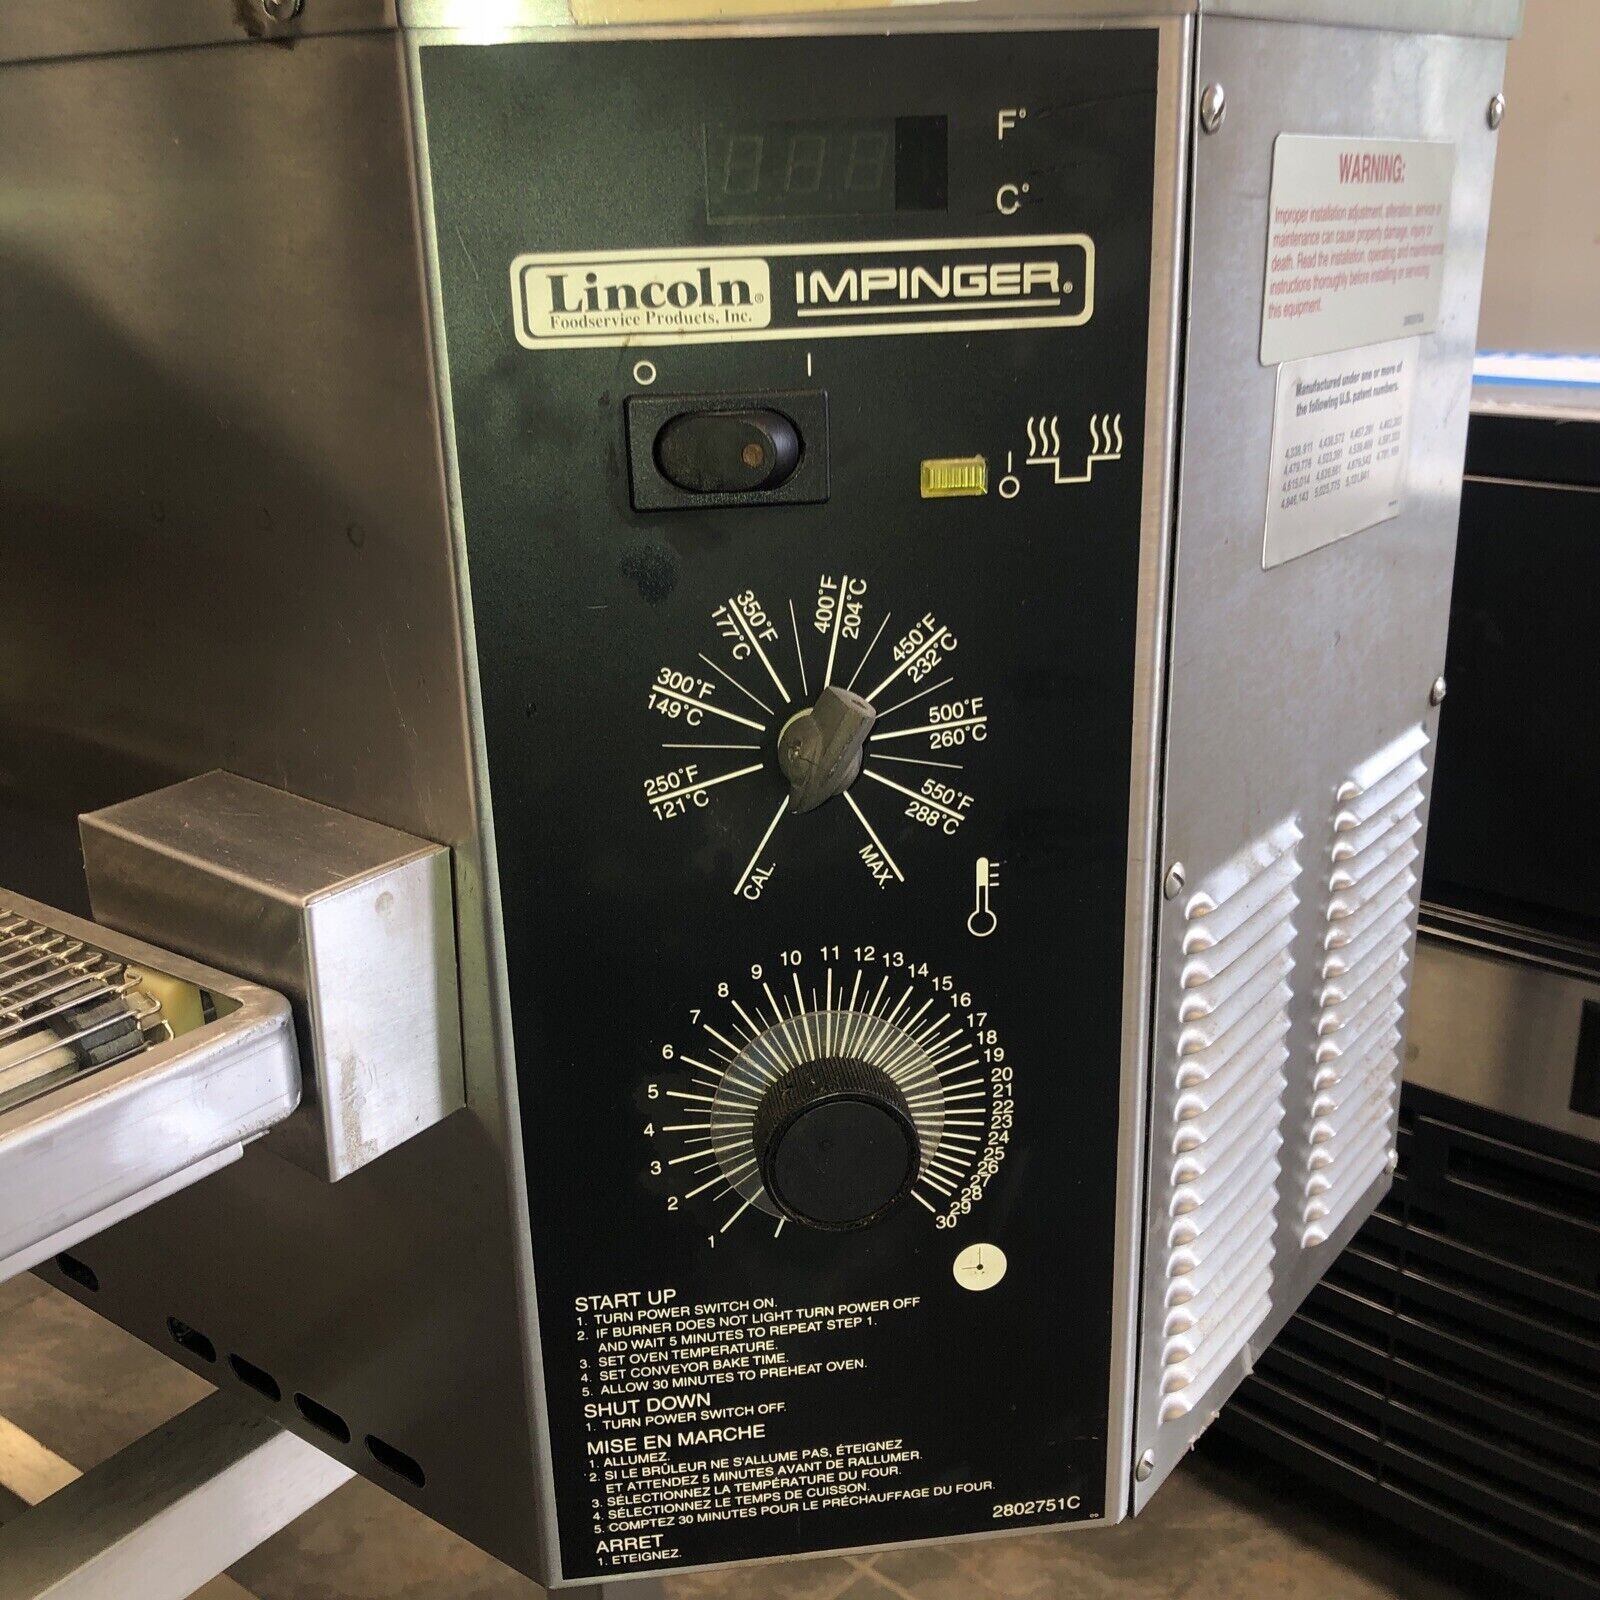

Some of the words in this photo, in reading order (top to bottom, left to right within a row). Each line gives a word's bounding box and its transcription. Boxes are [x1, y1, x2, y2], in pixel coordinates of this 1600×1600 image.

[1339, 152, 1405, 184] WARNING:
[795, 261, 1061, 303] IMPINGER
[550, 312, 641, 330] Foodservice
[646, 310, 720, 328] Products,
[724, 309, 752, 324] Inc.
[1296, 374, 1341, 397] Manufactured
[1343, 373, 1360, 386] under
[1309, 395, 1338, 414] following
[1352, 389, 1372, 403] patent
[738, 590, 778, 642] 350°F
[814, 575, 838, 634] 400°F
[842, 578, 866, 639] 204°C
[711, 605, 751, 660] 177°C
[892, 612, 937, 663] 450°F
[907, 635, 958, 682] 232°C
[657, 667, 716, 698] 300°F
[647, 694, 704, 726] 149°C
[929, 697, 984, 723] 500°F
[929, 724, 988, 749] 260°C
[644, 765, 700, 797] 250°F
[652, 790, 709, 820] 121°C
[920, 779, 975, 810] 550°F
[904, 802, 960, 836] 288°C
[859, 843, 893, 890] MAX.
[743, 861, 777, 900] CAL.
[780, 950, 802, 966] 10
[820, 946, 839, 960] 11
[854, 946, 875, 962] 12
[883, 952, 904, 967] 13
[751, 965, 762, 979] 9
[908, 964, 928, 978] 14
[718, 983, 729, 997] 8
[932, 977, 953, 991] 15
[950, 993, 971, 1007] 16
[690, 1010, 700, 1024] 7
[967, 1013, 987, 1027] 17
[977, 1030, 997, 1045] 18
[663, 1045, 674, 1059] 6
[984, 1048, 1004, 1063] 19
[991, 1068, 1012, 1082] 20
[648, 1084, 659, 1099] 5
[993, 1084, 1012, 1097] 21
[992, 1100, 1013, 1114] 22
[644, 1123, 655, 1137] 4
[991, 1116, 1012, 1129] 23
[988, 1131, 1009, 1144] 24
[984, 1147, 1004, 1161] 25
[650, 1161, 662, 1175] 3
[977, 1161, 998, 1174] 26
[970, 1175, 991, 1188] 27
[668, 1196, 678, 1210] 2
[961, 1188, 982, 1201] 28
[950, 1202, 971, 1215] 29
[936, 1215, 957, 1229] 30
[708, 1236, 714, 1248] 1
[574, 1291, 641, 1312] START
[647, 1288, 676, 1305] UP
[576, 1316, 587, 1326] 1.
[593, 1311, 633, 1324] TURN
[637, 1305, 690, 1320] POWER
[694, 1300, 749, 1315] SWITCH
[752, 1297, 777, 1309] ON.
[576, 1330, 588, 1341] 2.
[596, 1327, 608, 1339] IF
[612, 1322, 672, 1337] BURNER
[675, 1317, 716, 1331] DOES
[719, 1314, 748, 1326] NOT
[752, 1309, 793, 1323] LIGHT
[795, 1305, 834, 1319] TURN
[838, 1299, 889, 1314] POWER
[892, 1296, 920, 1309] OFF
[597, 1340, 628, 1353] AND
[631, 1336, 666, 1349] WAIT
[680, 1328, 744, 1345] 5
[746, 1326, 766, 1338] MINUTES
[769, 1320, 823, 1336] TO
[826, 1316, 862, 1330] REPEAT
[866, 1315, 877, 1326] 1.
[579, 1358, 590, 1369] 3.
[598, 1354, 625, 1367] SET
[628, 1350, 668, 1364] OVEN
[670, 1339, 778, 1359] TEMPERATURE.
[580, 1372, 592, 1382] 4.
[599, 1368, 626, 1381] SET
[630, 1360, 709, 1378] CONVEYOR
[712, 1356, 750, 1370] BAKE
[752, 1352, 788, 1365] TIME.
[582, 1386, 593, 1396] 5.
[600, 1380, 648, 1395] ALLOW
[652, 1379, 668, 1390] 30
[672, 1372, 734, 1388] MINUTES
[736, 1369, 756, 1380] TO
[759, 1362, 822, 1378] PREHEAT
[826, 1358, 867, 1372] OVEN.
[584, 1399, 640, 1418] SHUT
[646, 1392, 710, 1412] DOWN
[586, 1422, 596, 1431] 1.
[602, 1417, 641, 1430] TURN
[644, 1411, 696, 1426] POWER
[700, 1405, 754, 1420] SWITCH
[757, 1401, 786, 1414] OFF.
[586, 1436, 637, 1455] MISE
[643, 1433, 671, 1450] EN
[677, 1423, 765, 1446] MARCHE
[589, 1459, 599, 1468] 1.
[603, 1451, 670, 1467] ALLUMEZ.
[589, 1472, 600, 1482] 2.
[604, 1470, 617, 1480] SI
[621, 1467, 638, 1479] LE
[641, 1460, 706, 1476] BRÛLEUR
[710, 1458, 729, 1469] NE
[732, 1450, 798, 1467] S'ALLUME
[802, 1447, 832, 1459] PAS,
[836, 1438, 902, 1455] ÉTEIGNEZ
[605, 1482, 623, 1494] ET
[626, 1474, 699, 1491] ATTENDEZ
[702, 1473, 710, 1483] 5
[713, 1466, 774, 1482] MINUTES
[777, 1460, 822, 1475] AVANT
[825, 1458, 844, 1470] DE
[847, 1450, 922, 1467] RALLUMER.
[591, 1498, 602, 1508] 3.
[606, 1486, 711, 1508] SÉLECTIONNEZ
[714, 1484, 731, 1495] LA
[733, 1472, 834, 1492] TEMPÉRATURE
[838, 1470, 857, 1481] DU
[861, 1465, 901, 1478] FOUR.
[592, 1511, 604, 1520] 4.
[608, 1499, 711, 1519] SÉLECTIONNEZ
[714, 1497, 731, 1508] LE
[734, 1491, 781, 1505] TEMPS
[784, 1489, 802, 1500] DE
[806, 1482, 870, 1498] CUISSON.
[594, 1524, 604, 1534] 5.
[608, 1516, 675, 1532] COMPTEZ
[678, 1514, 694, 1524] 30
[696, 1507, 757, 1522] MINUTES
[760, 1502, 798, 1515] POUR
[802, 1500, 818, 1511] LE
[822, 1487, 930, 1508] PRÉCHAUFFAGE
[933, 1485, 952, 1496] DU
[955, 1480, 995, 1493] FOUR.
[992, 1496, 1081, 1519] 2802751C
[595, 1533, 664, 1554] ARRET
[598, 1557, 608, 1566] 1.
[612, 1548, 682, 1564] ETEIGNEZ.
